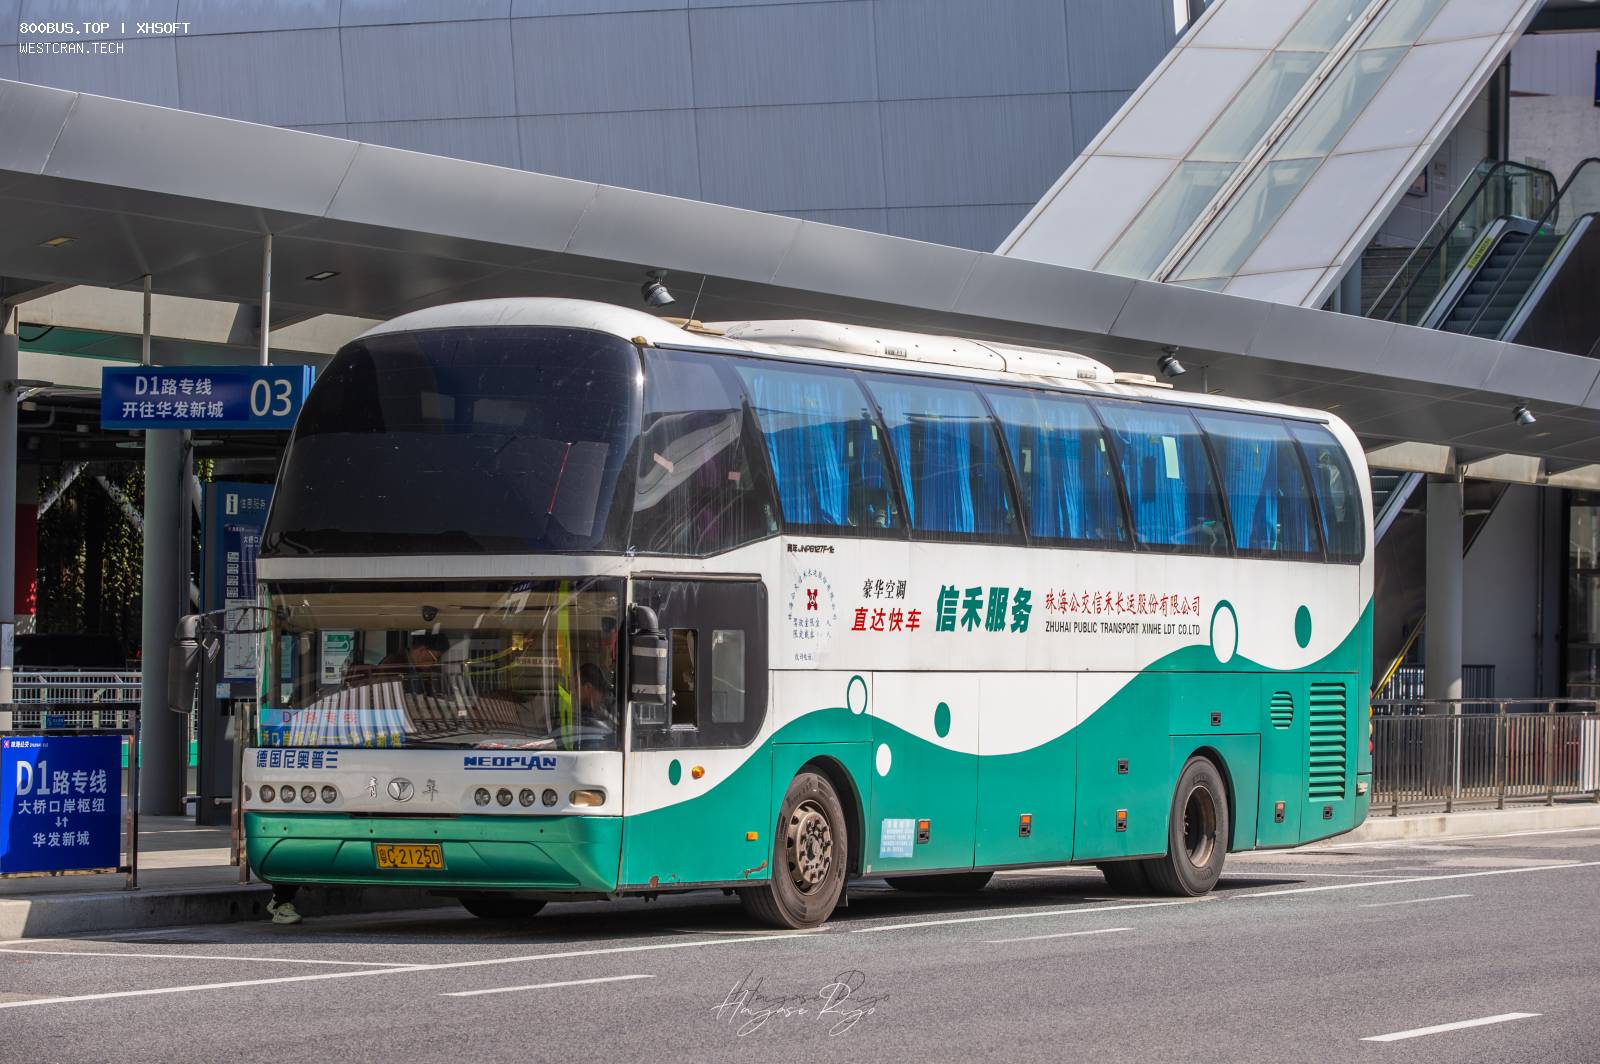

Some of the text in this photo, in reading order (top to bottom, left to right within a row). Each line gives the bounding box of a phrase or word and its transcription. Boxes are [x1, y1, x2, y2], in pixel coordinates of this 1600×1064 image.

[135, 376, 212, 396] D1路专线
[250, 379, 292, 417] 03
[122, 401, 224, 419] 开往华发新城
[863, 578, 907, 600] 豪华空调
[935, 584, 1033, 634] 信禾服务
[1045, 588, 1201, 617] 珠海公交信禾长运股份有限公司
[851, 606, 922, 632] 直达快车
[1045, 621, 1201, 636] ZHUHAI PUBLIC TRANSPORT XINHE LDT CO.LTD
[463, 756, 557, 770] NEOPLAN
[16, 760, 108, 796] D1路专线
[18, 798, 106, 815] 大桥口岸枢纽
[32, 831, 90, 848] 华发新城
